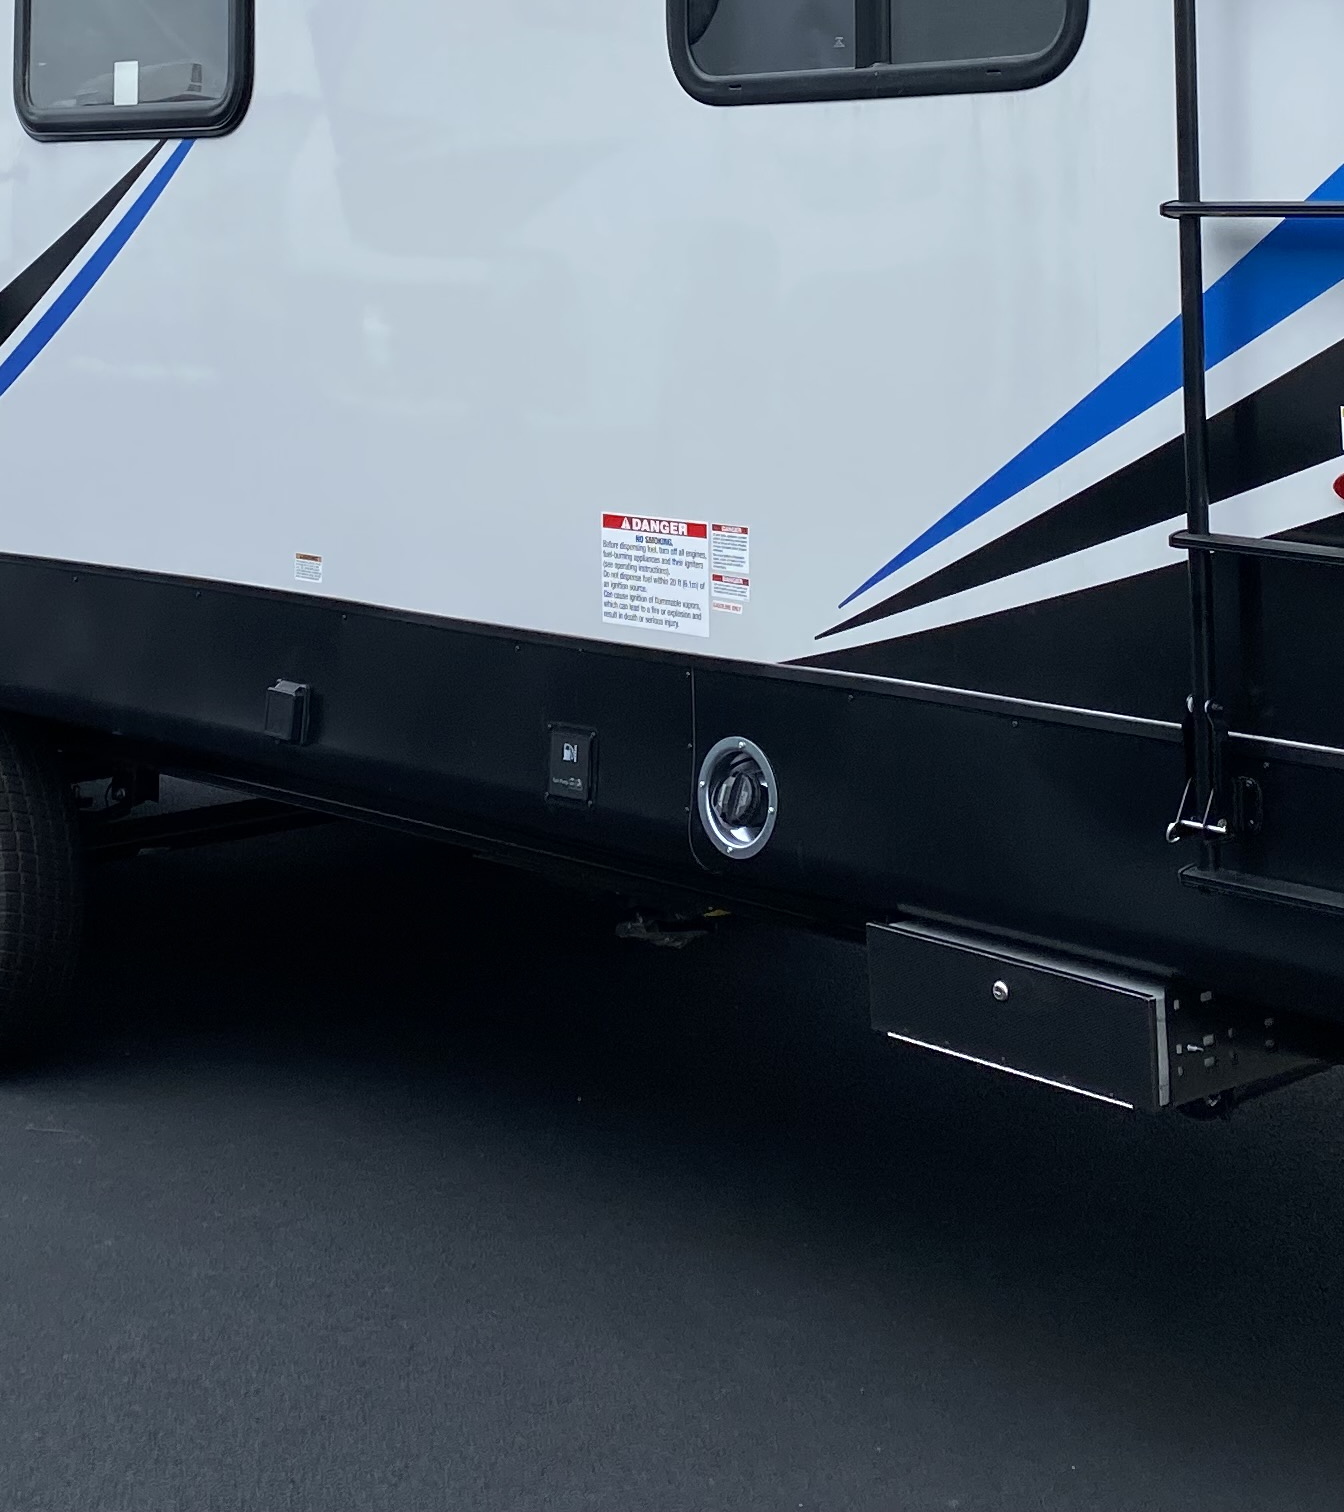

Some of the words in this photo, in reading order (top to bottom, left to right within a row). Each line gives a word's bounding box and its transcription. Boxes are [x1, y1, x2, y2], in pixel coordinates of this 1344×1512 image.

[632, 518, 688, 535] DANGER
[620, 542, 646, 553] dispensing
[670, 578, 676, 586] 20
